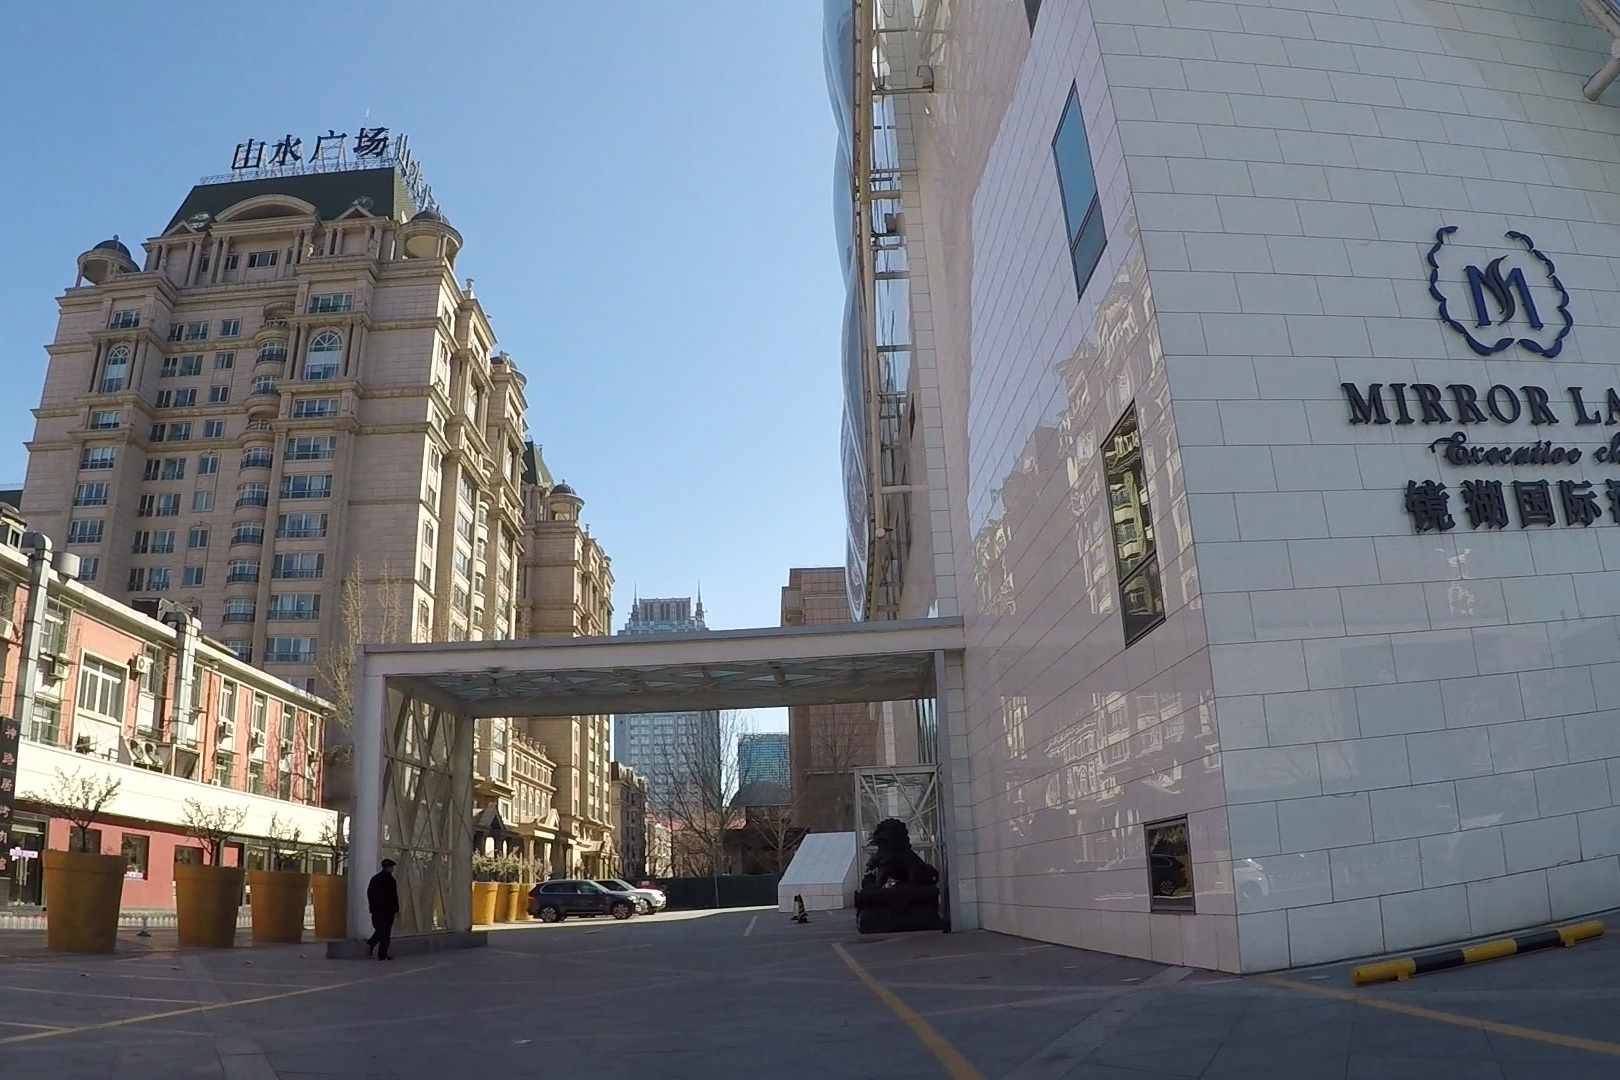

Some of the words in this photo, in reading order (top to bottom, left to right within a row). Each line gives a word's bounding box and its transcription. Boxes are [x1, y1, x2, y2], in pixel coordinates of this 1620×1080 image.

[231, 127, 389, 170] 山水广场
[1341, 382, 1560, 426] MIRROR
